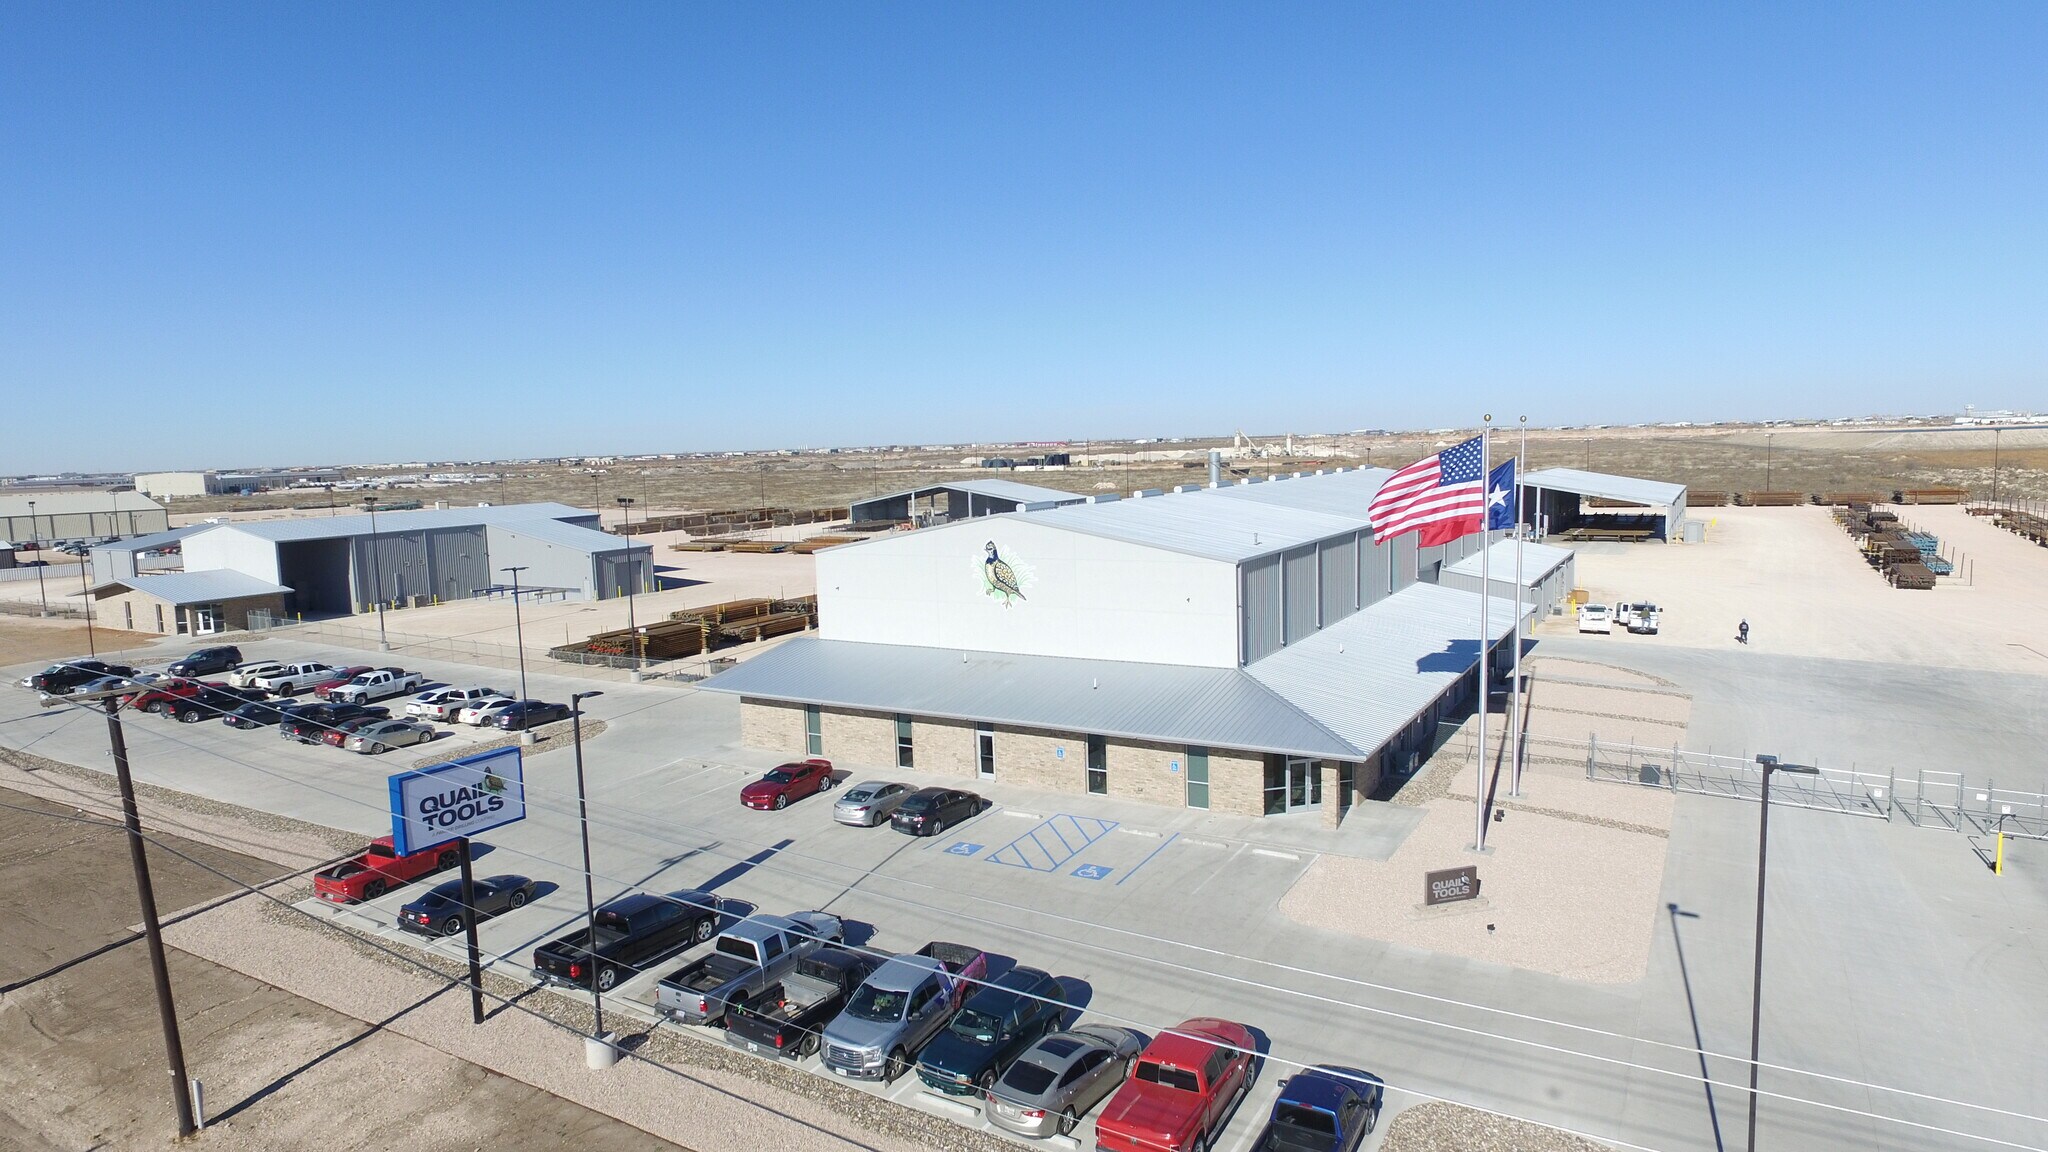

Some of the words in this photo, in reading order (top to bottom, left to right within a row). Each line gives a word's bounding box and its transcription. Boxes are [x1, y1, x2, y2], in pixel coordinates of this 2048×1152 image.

[419, 782, 490, 814] QUAIL
[422, 795, 504, 832] TOOLS
[1432, 878, 1464, 890] QUAIL
[1432, 885, 1470, 899] TOOLS
